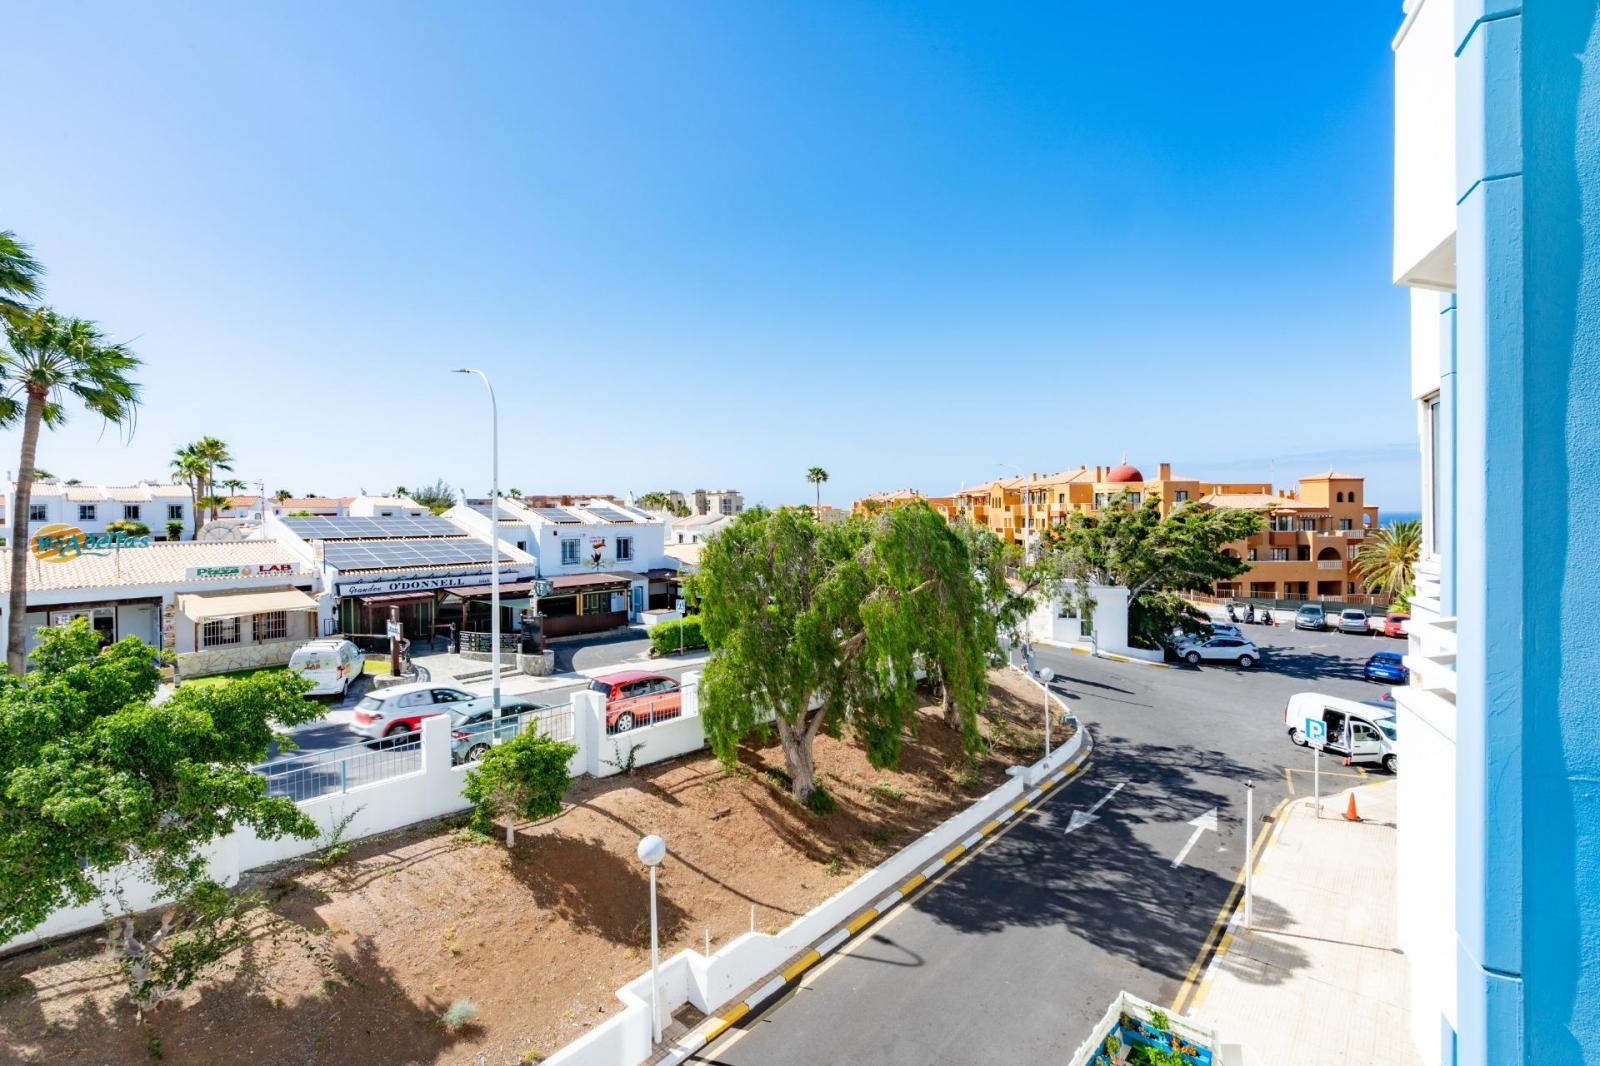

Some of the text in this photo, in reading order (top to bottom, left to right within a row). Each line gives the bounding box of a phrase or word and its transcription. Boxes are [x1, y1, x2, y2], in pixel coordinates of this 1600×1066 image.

[196, 567, 240, 577] Pizza
[389, 578, 465, 591] O'DONNELL
[1309, 718, 1323, 739] P
